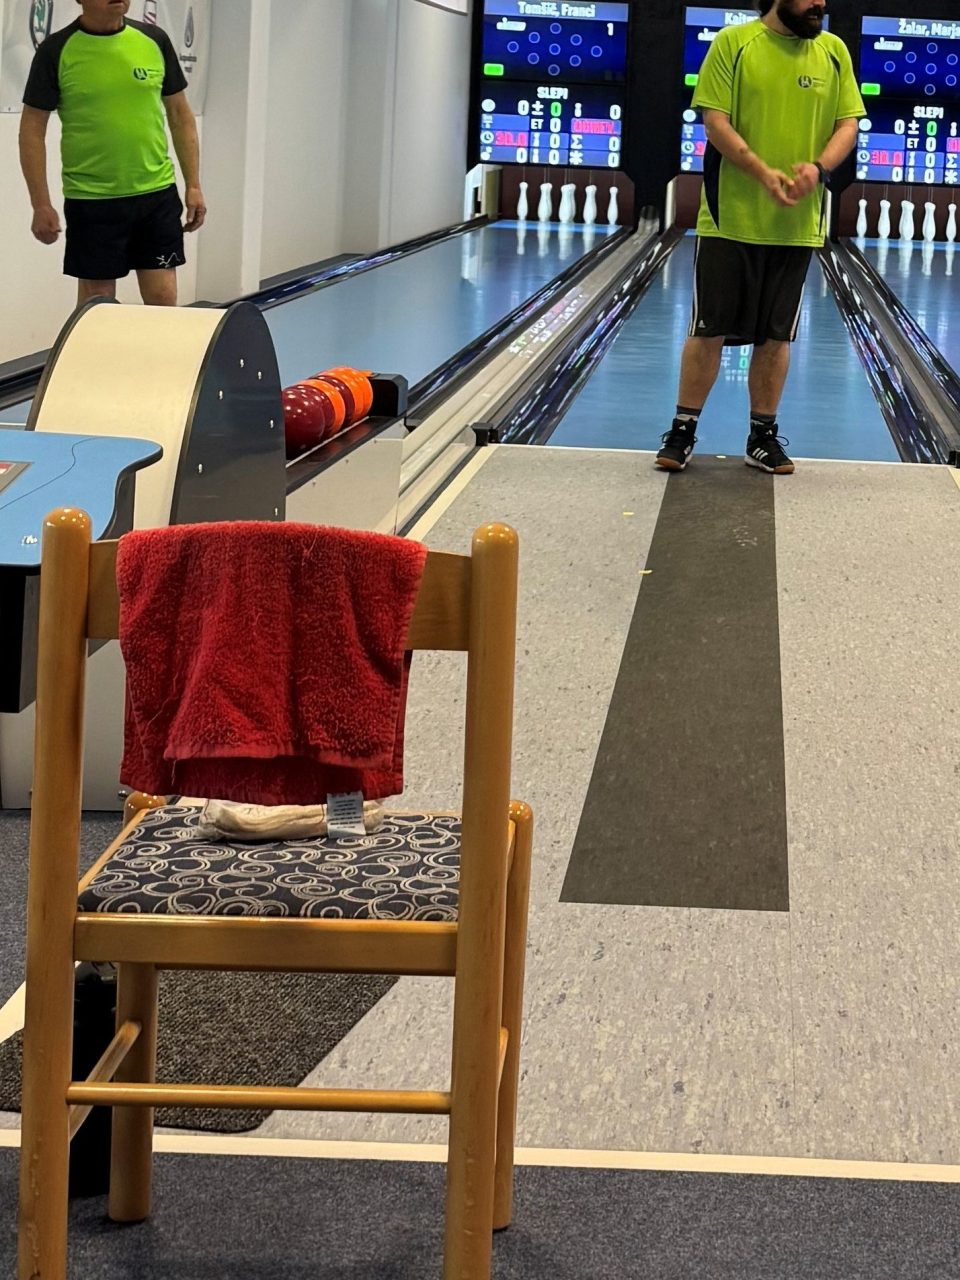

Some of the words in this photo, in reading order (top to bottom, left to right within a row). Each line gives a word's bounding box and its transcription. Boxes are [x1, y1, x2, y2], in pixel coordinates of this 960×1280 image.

[561, 3, 596, 18] Franci
[606, 22, 615, 36] 1
[536, 86, 569, 100] SLEPI
[913, 105, 944, 119] SLEPI
